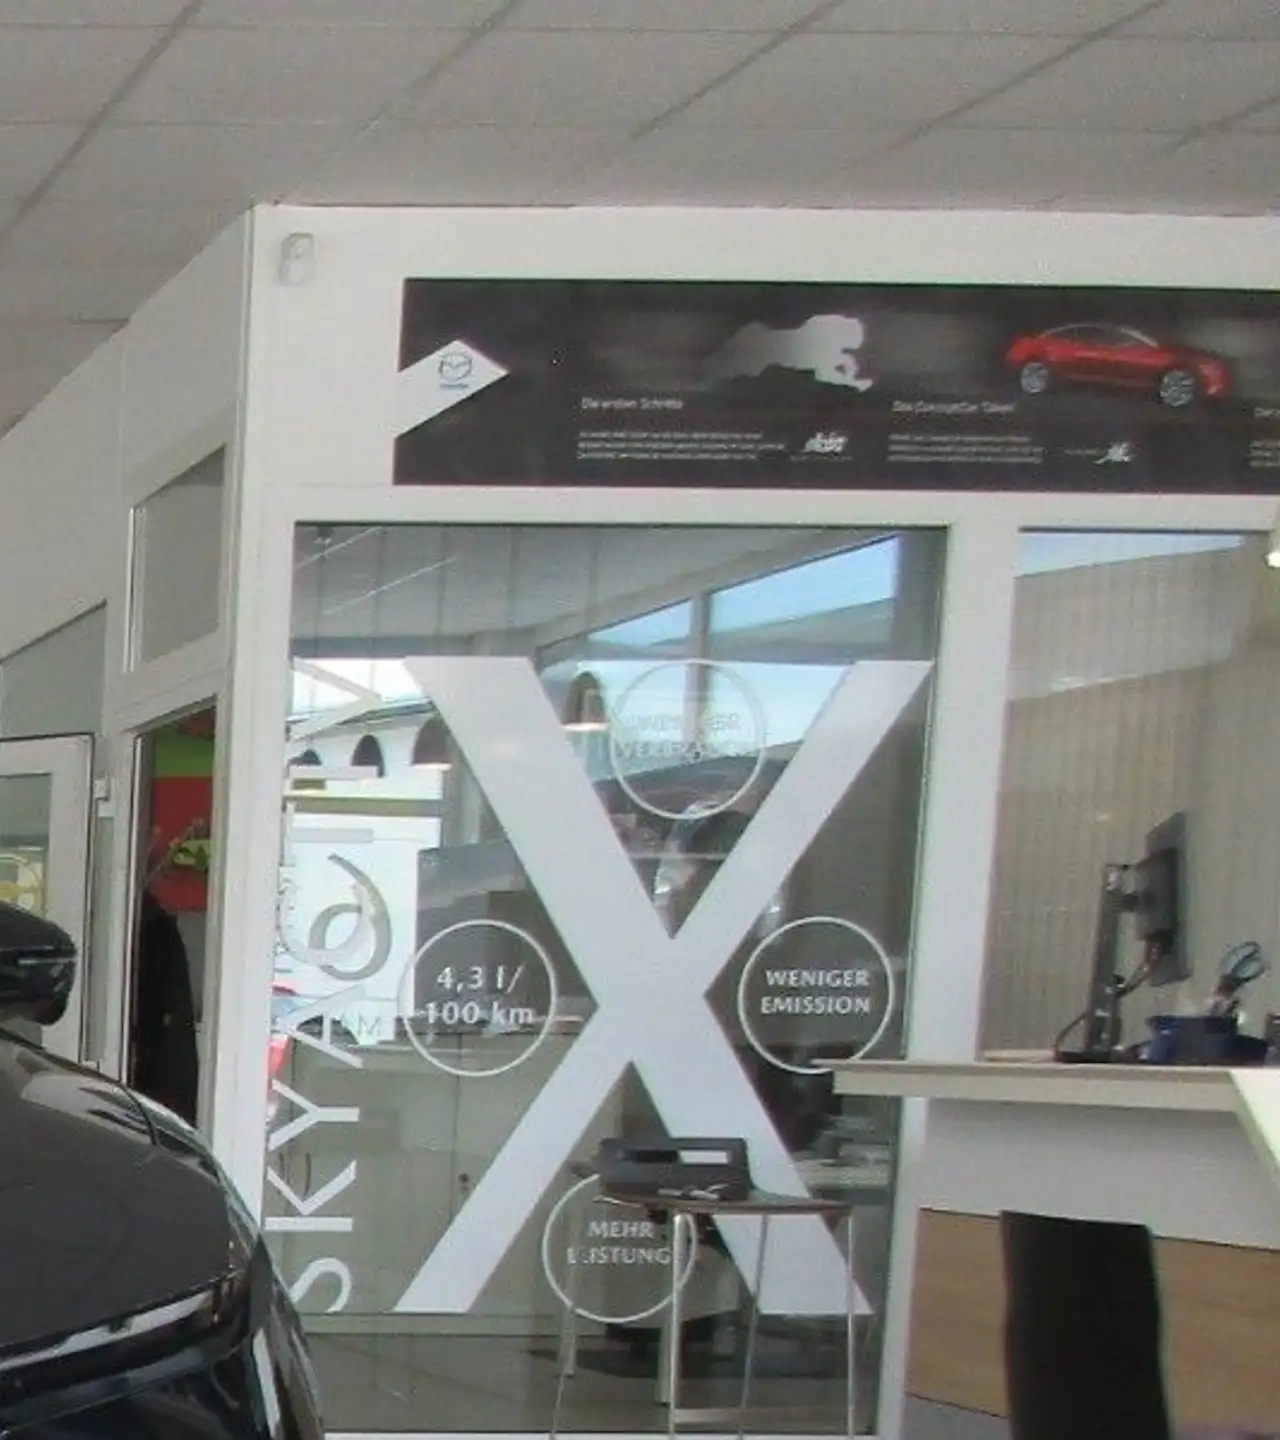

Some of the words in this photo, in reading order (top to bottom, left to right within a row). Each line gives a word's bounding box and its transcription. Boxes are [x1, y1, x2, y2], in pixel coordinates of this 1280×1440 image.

[436, 964, 483, 993] 4,3
[764, 968, 871, 988] WENIGER
[425, 1000, 481, 1025] 100
[491, 1000, 535, 1025] km
[760, 995, 872, 1015] EMISSION
[588, 1220, 655, 1239] MEHR
